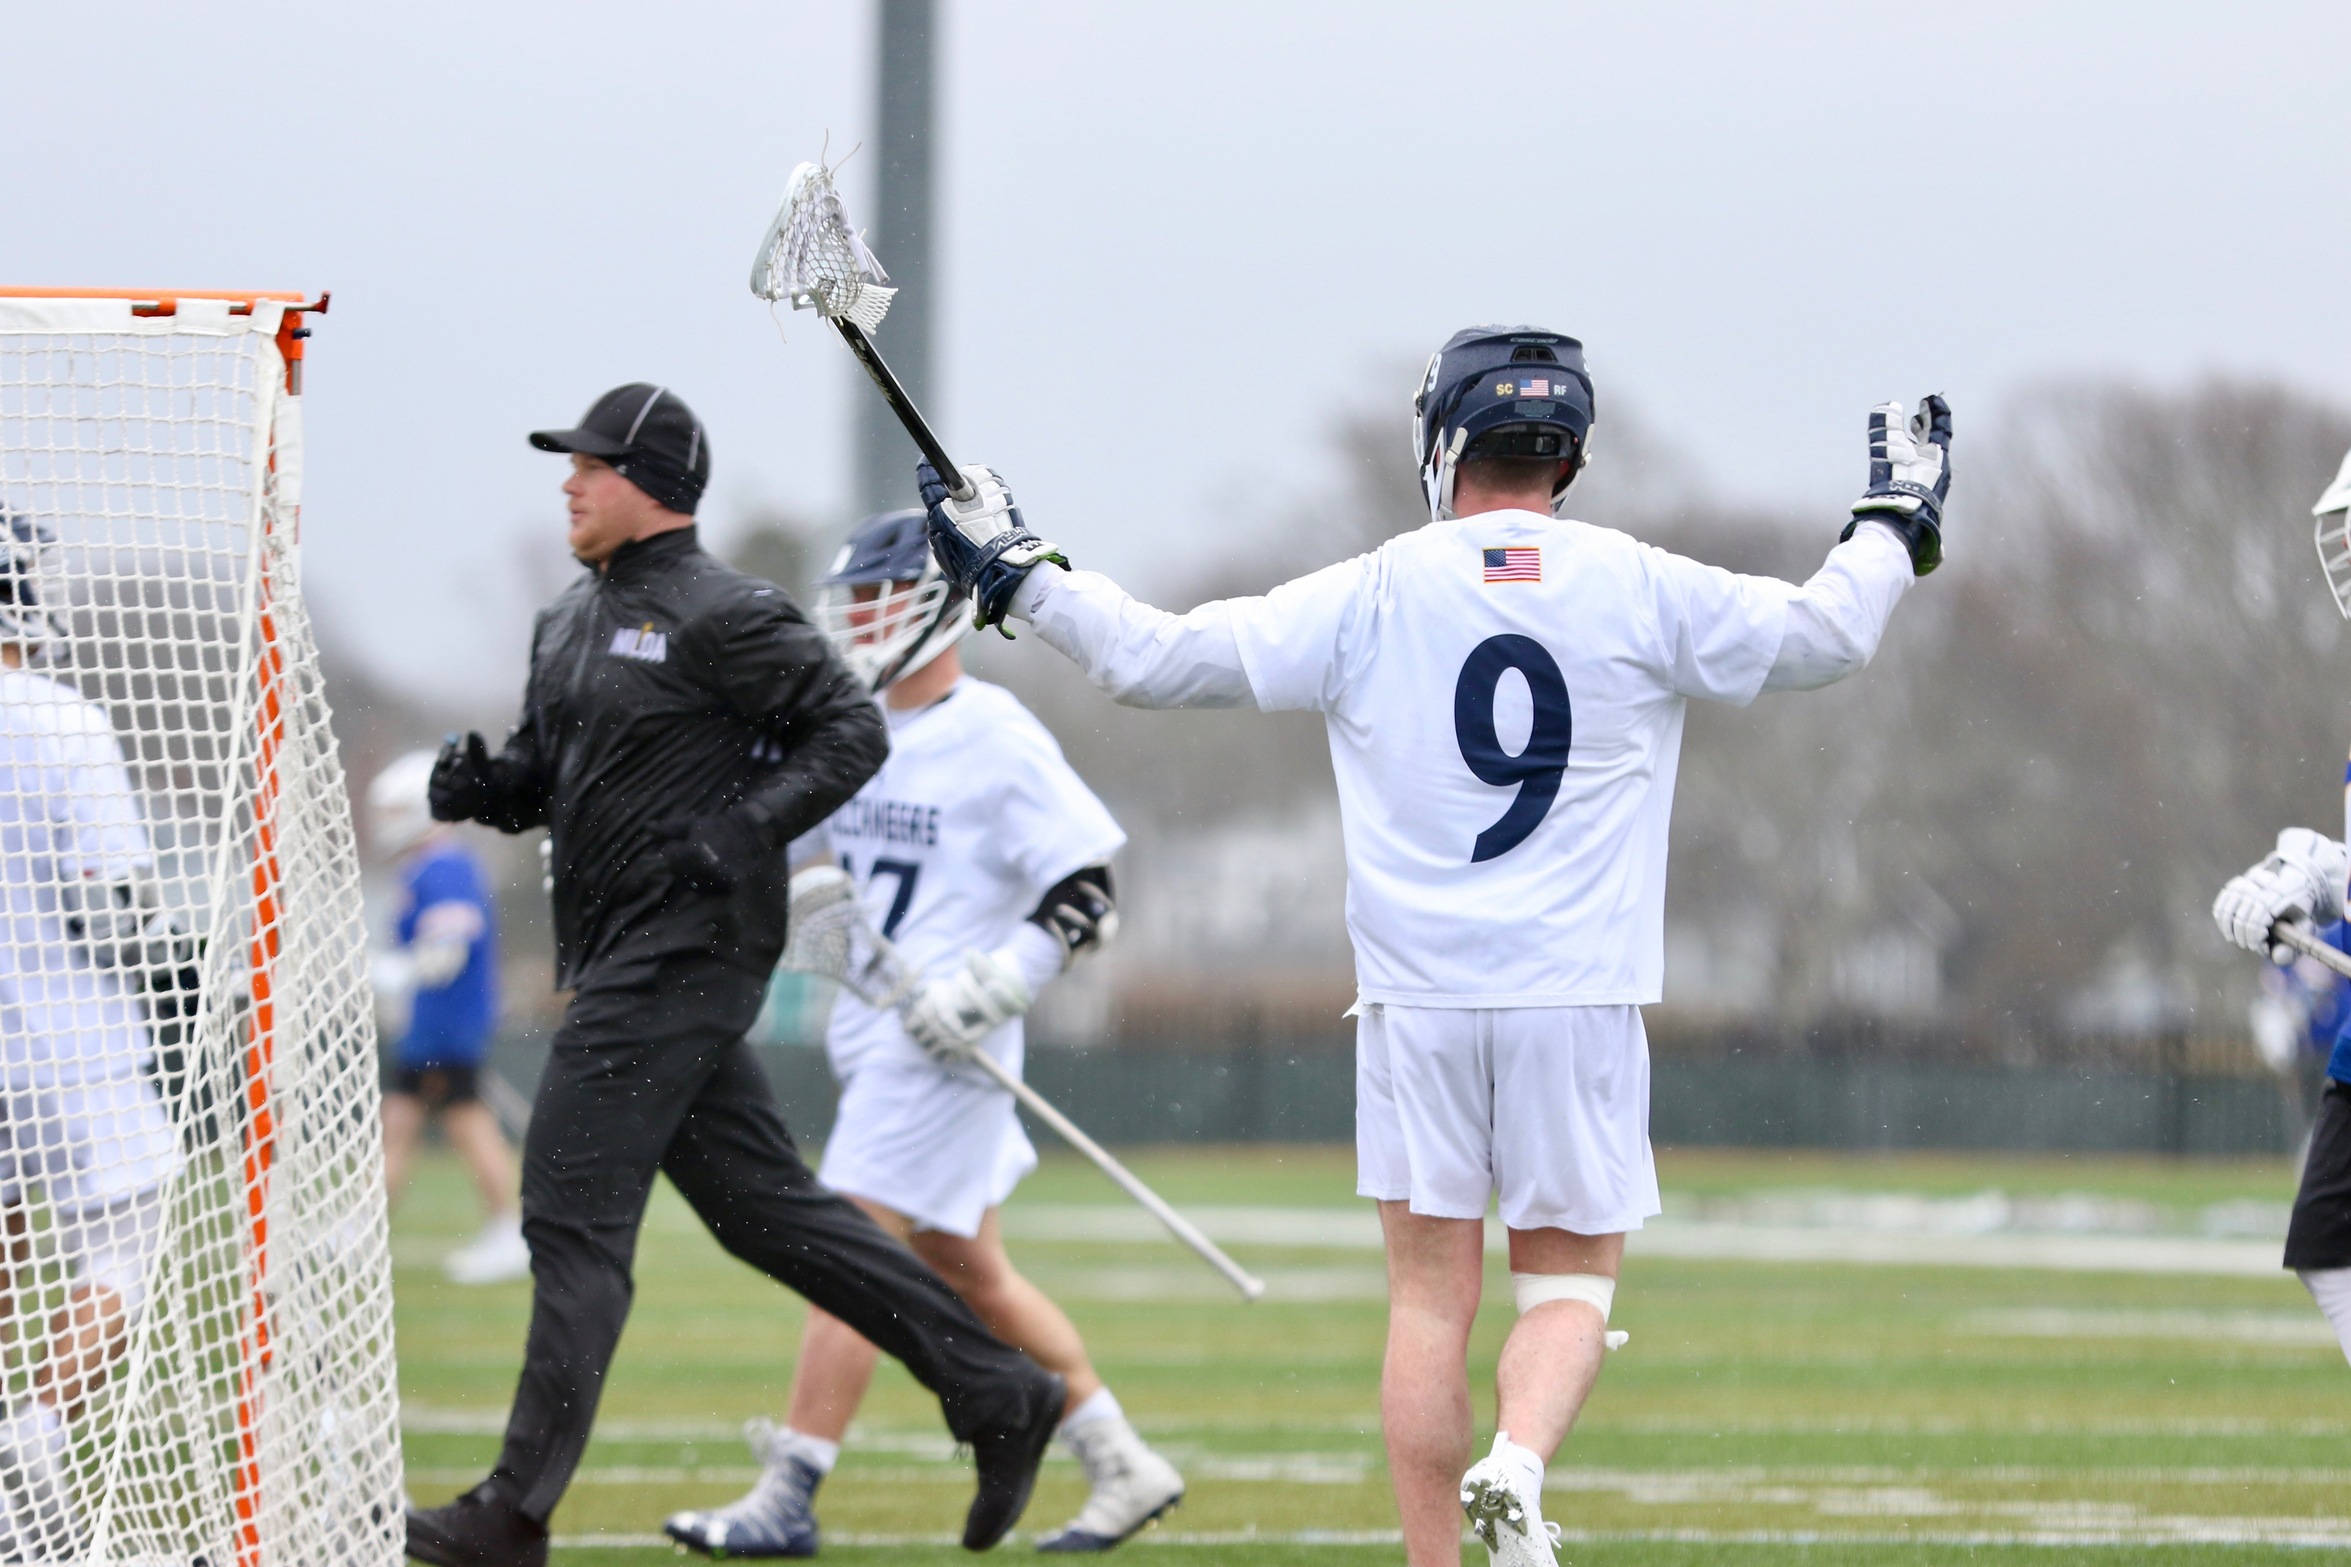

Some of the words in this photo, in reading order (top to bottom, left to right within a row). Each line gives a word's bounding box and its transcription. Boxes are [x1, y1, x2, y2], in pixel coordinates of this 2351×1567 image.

[1496, 383, 1513, 396] SC
[1553, 384, 1567, 396] RF
[1454, 633, 1572, 863] 9
